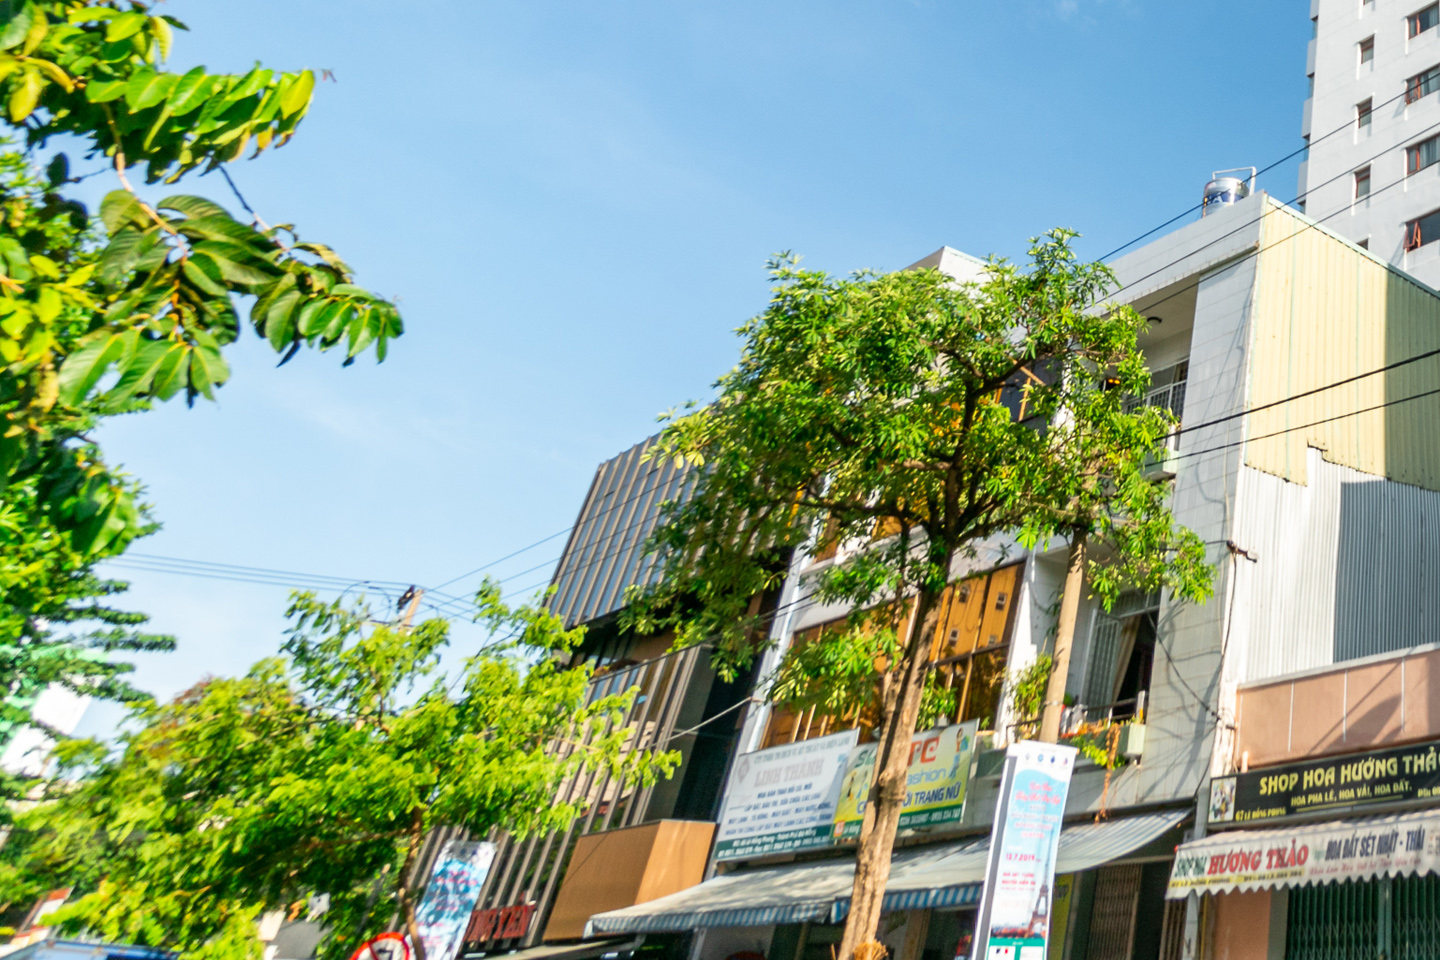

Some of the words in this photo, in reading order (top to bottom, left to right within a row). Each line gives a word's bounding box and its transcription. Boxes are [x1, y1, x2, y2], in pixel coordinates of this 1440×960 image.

[906, 768, 946, 787] ashion
[1259, 772, 1299, 796] SHOP
[1302, 766, 1336, 790] HOA
[914, 787, 945, 805] TRANG
[1339, 788, 1355, 800] HOA
[1374, 783, 1391, 796] HOA
[1266, 838, 1309, 869] THẢO
